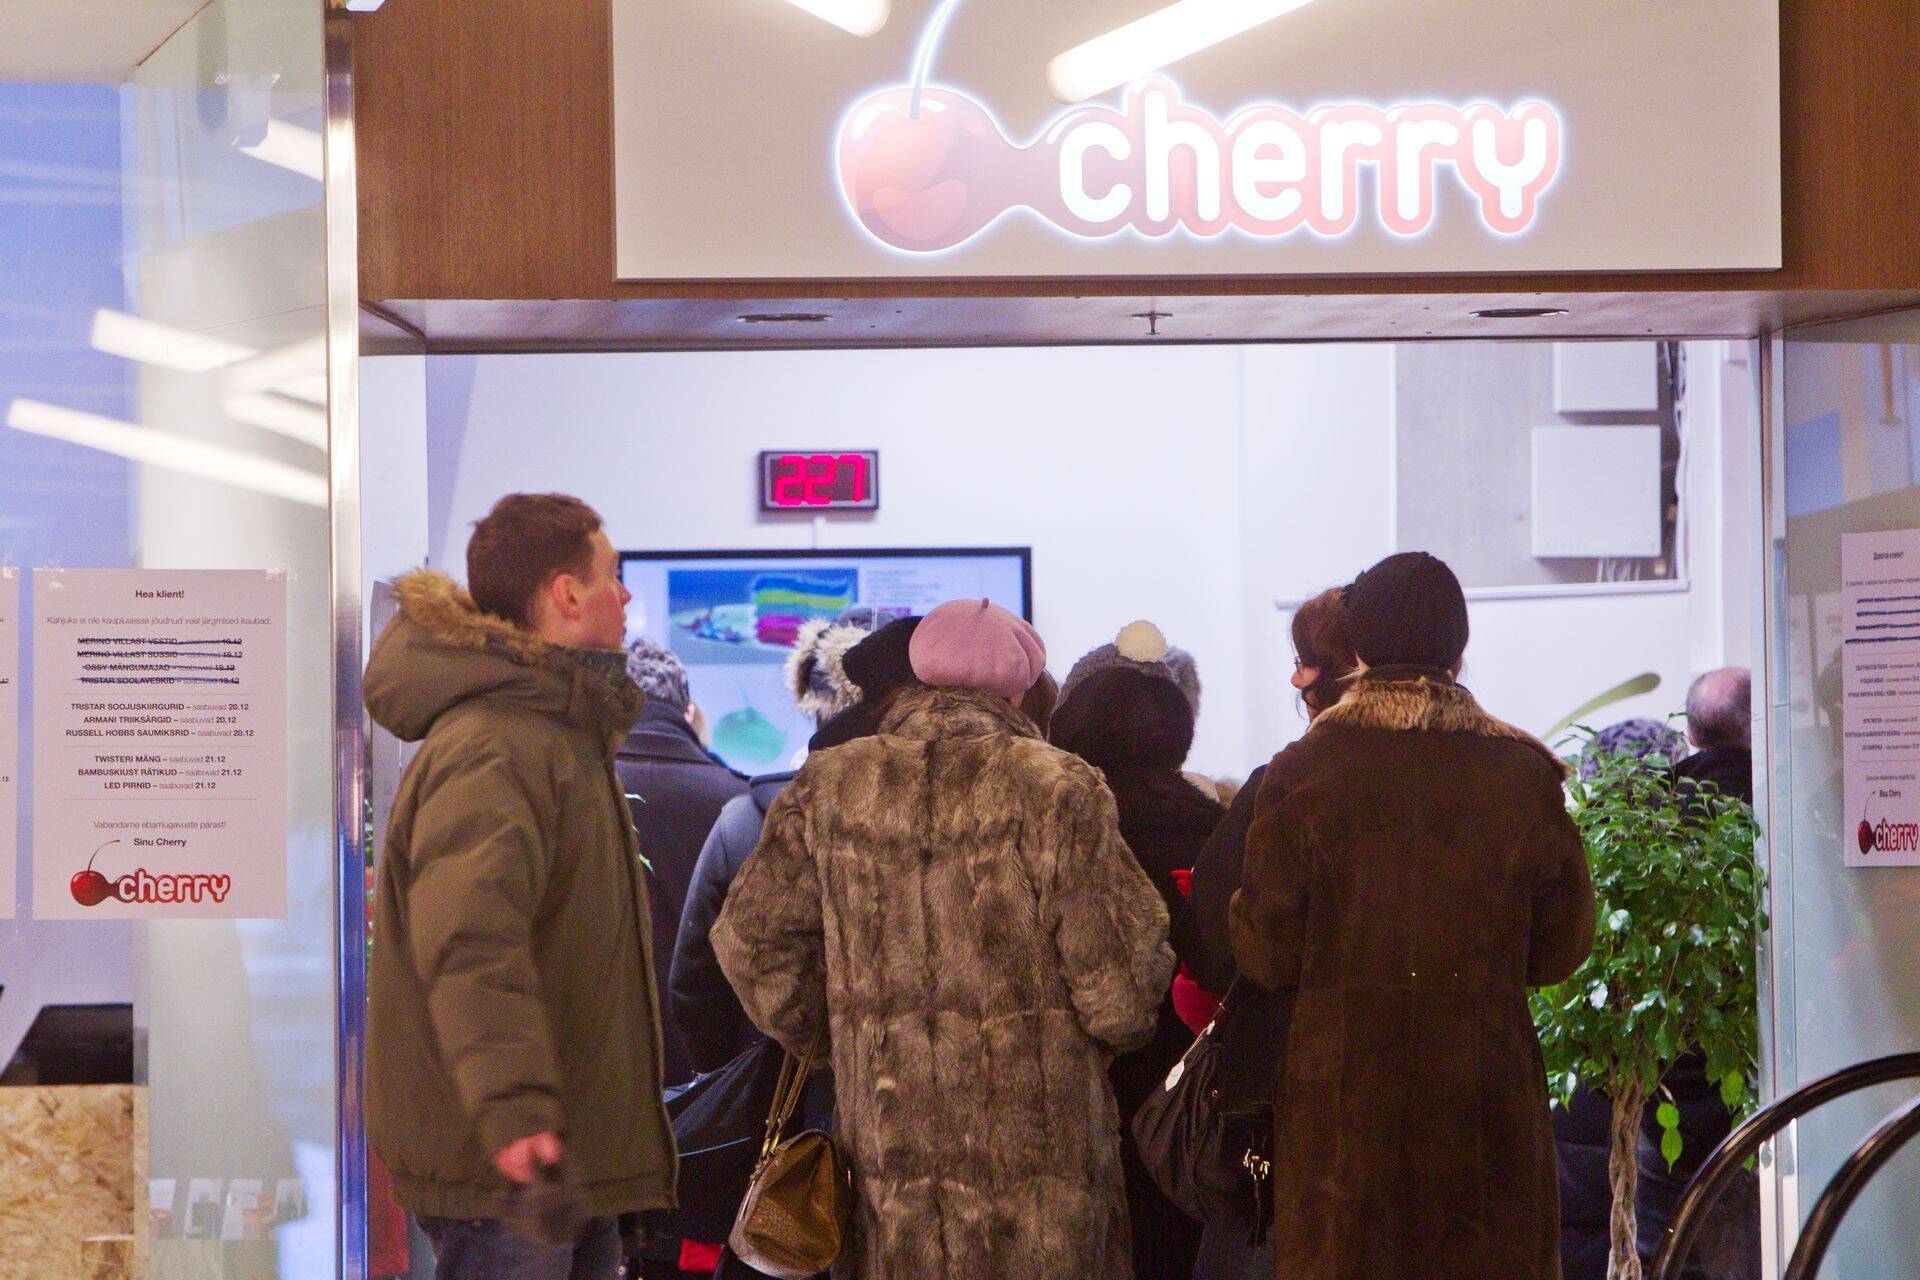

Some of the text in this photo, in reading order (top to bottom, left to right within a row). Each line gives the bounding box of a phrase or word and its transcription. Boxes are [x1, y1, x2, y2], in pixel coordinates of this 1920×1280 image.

[1055, 82, 1552, 230] cherry
[775, 454, 865, 506] 227
[135, 590, 184, 599] Hea klient!
[47, 616, 79, 626] Kahjuks
[88, 616, 100, 625] ole
[184, 616, 200, 625] veel
[201, 616, 239, 626] järgmised
[192, 703, 227, 711] saabuvad
[228, 703, 249, 711] 20.12
[119, 715, 172, 724] TRIIKSÄRGID
[180, 716, 214, 724] saabuvad
[216, 716, 237, 724] 20.12
[65, 729, 254, 737] RUSSELL HOBBS SAUMIKSRID saabuvad 20.12
[95, 754, 226, 763] TWISTERI MÄNG saabuvad 21.12
[78, 767, 242, 776] BAMBUSKIUST RÄTIKUD saabuvad 21.12
[93, 821, 139, 829] Vabandame
[141, 821, 198, 830] ebamugavuste
[1875, 817, 1919, 852] cherry
[133, 838, 187, 848] Sinu Cherry
[117, 868, 230, 903] cherry
